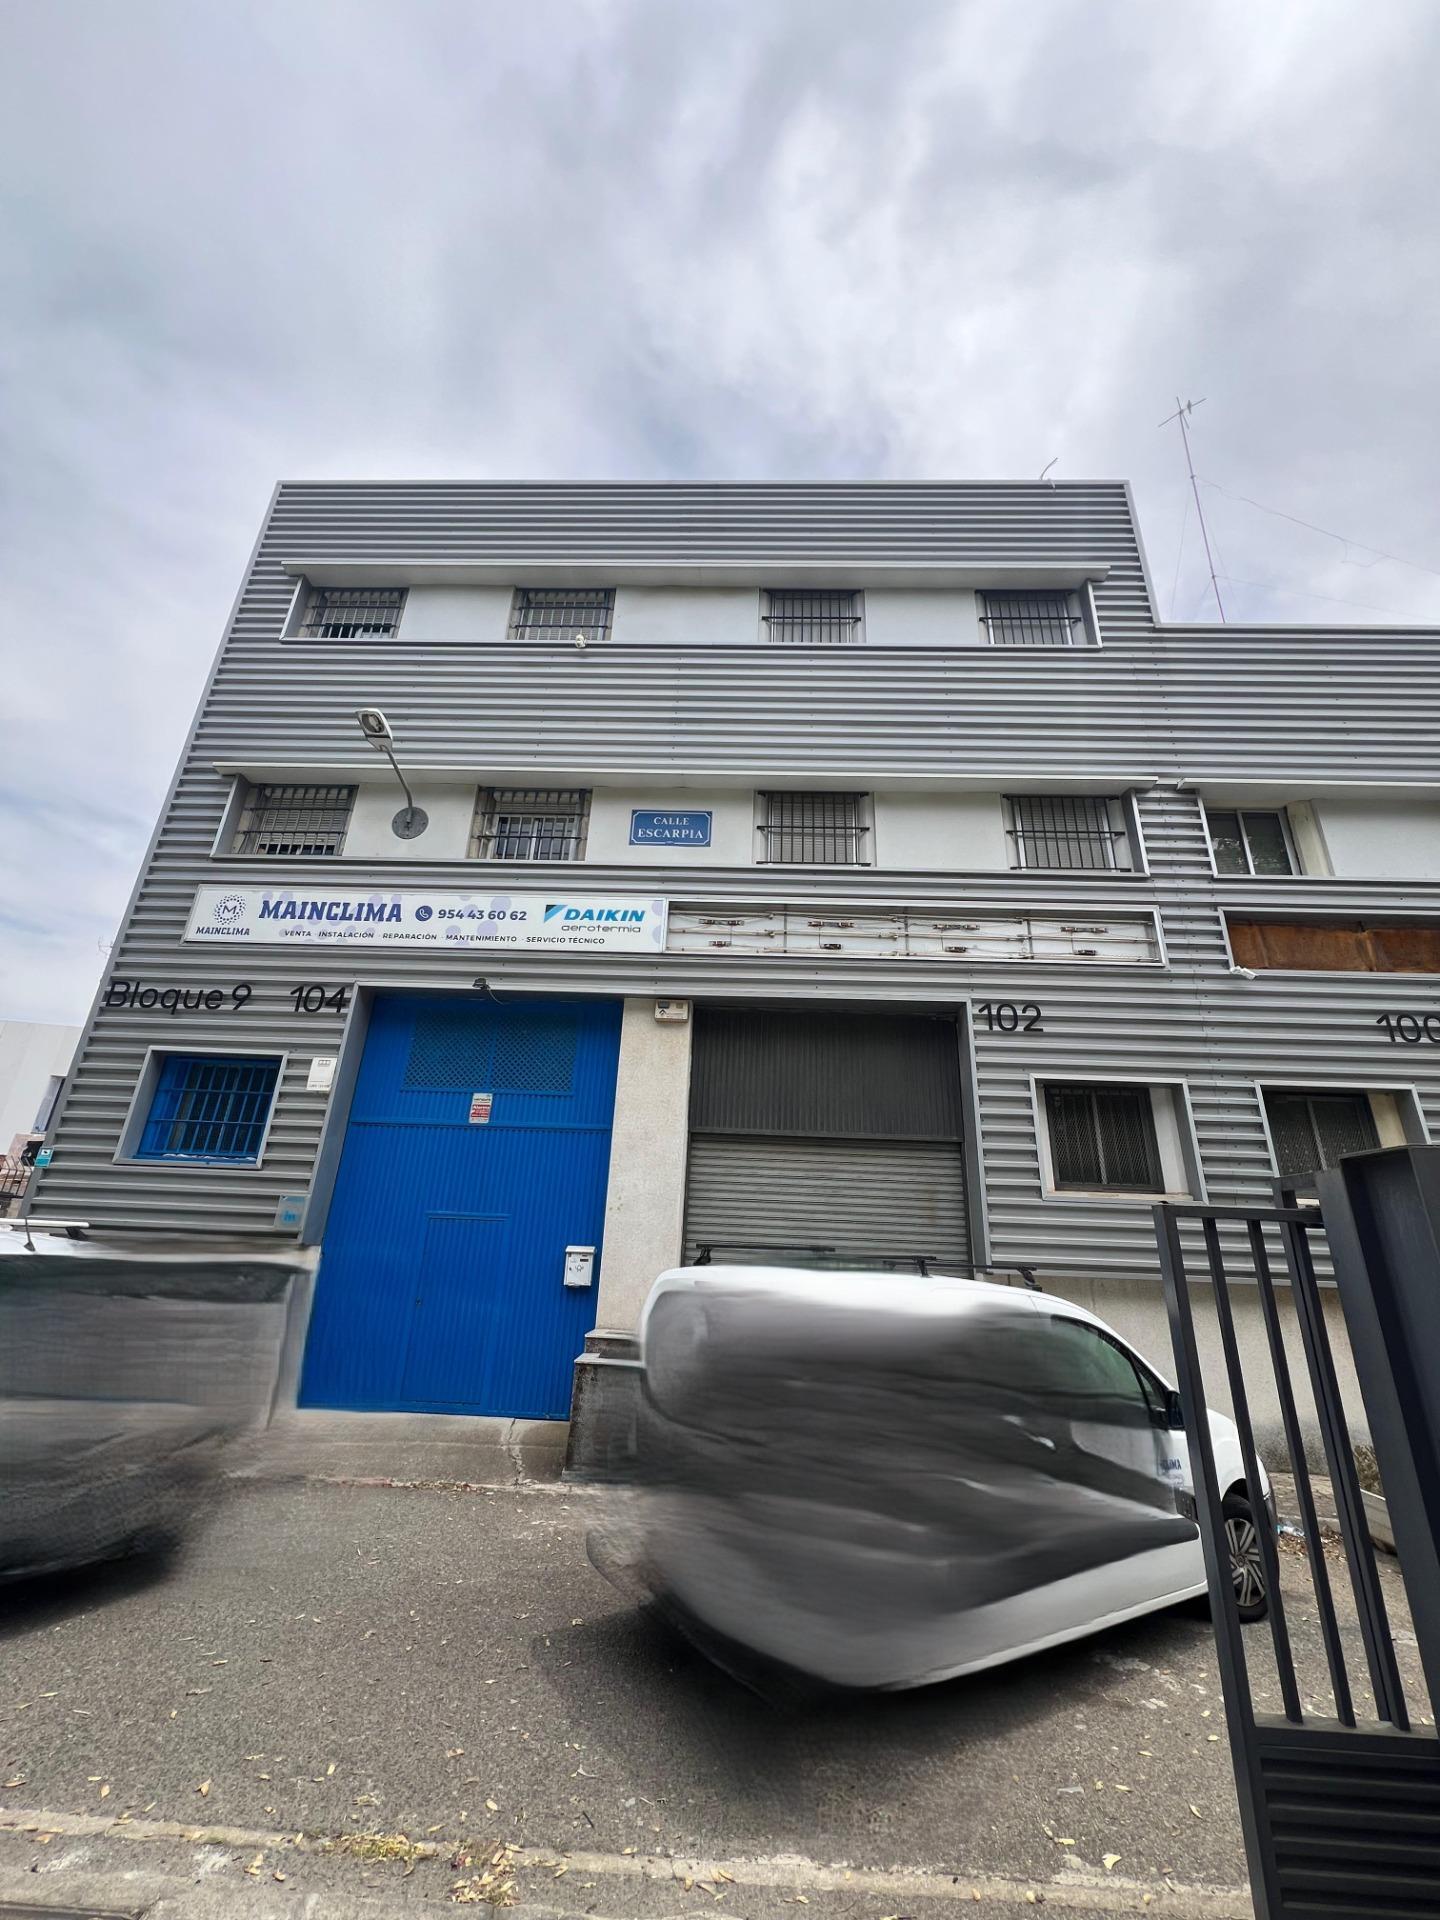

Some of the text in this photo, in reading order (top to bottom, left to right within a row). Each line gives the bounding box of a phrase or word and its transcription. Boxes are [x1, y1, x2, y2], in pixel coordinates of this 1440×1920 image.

[653, 816, 690, 826] CALLE
[637, 828, 704, 839] ESCARPIA
[258, 900, 402, 922] MAINCLIMA
[437, 908, 528, 921] 954 43 60 62
[563, 908, 646, 922] DAIKIN
[195, 926, 250, 936] MAINCLIMA
[561, 924, 641, 933] aerotermia
[446, 934, 518, 942] MANTENIMIENTO
[526, 936, 566, 944] SERVICIO
[105, 981, 253, 1016] Bloque 9
[290, 985, 347, 1013] 104
[978, 1003, 1044, 1032] 102
